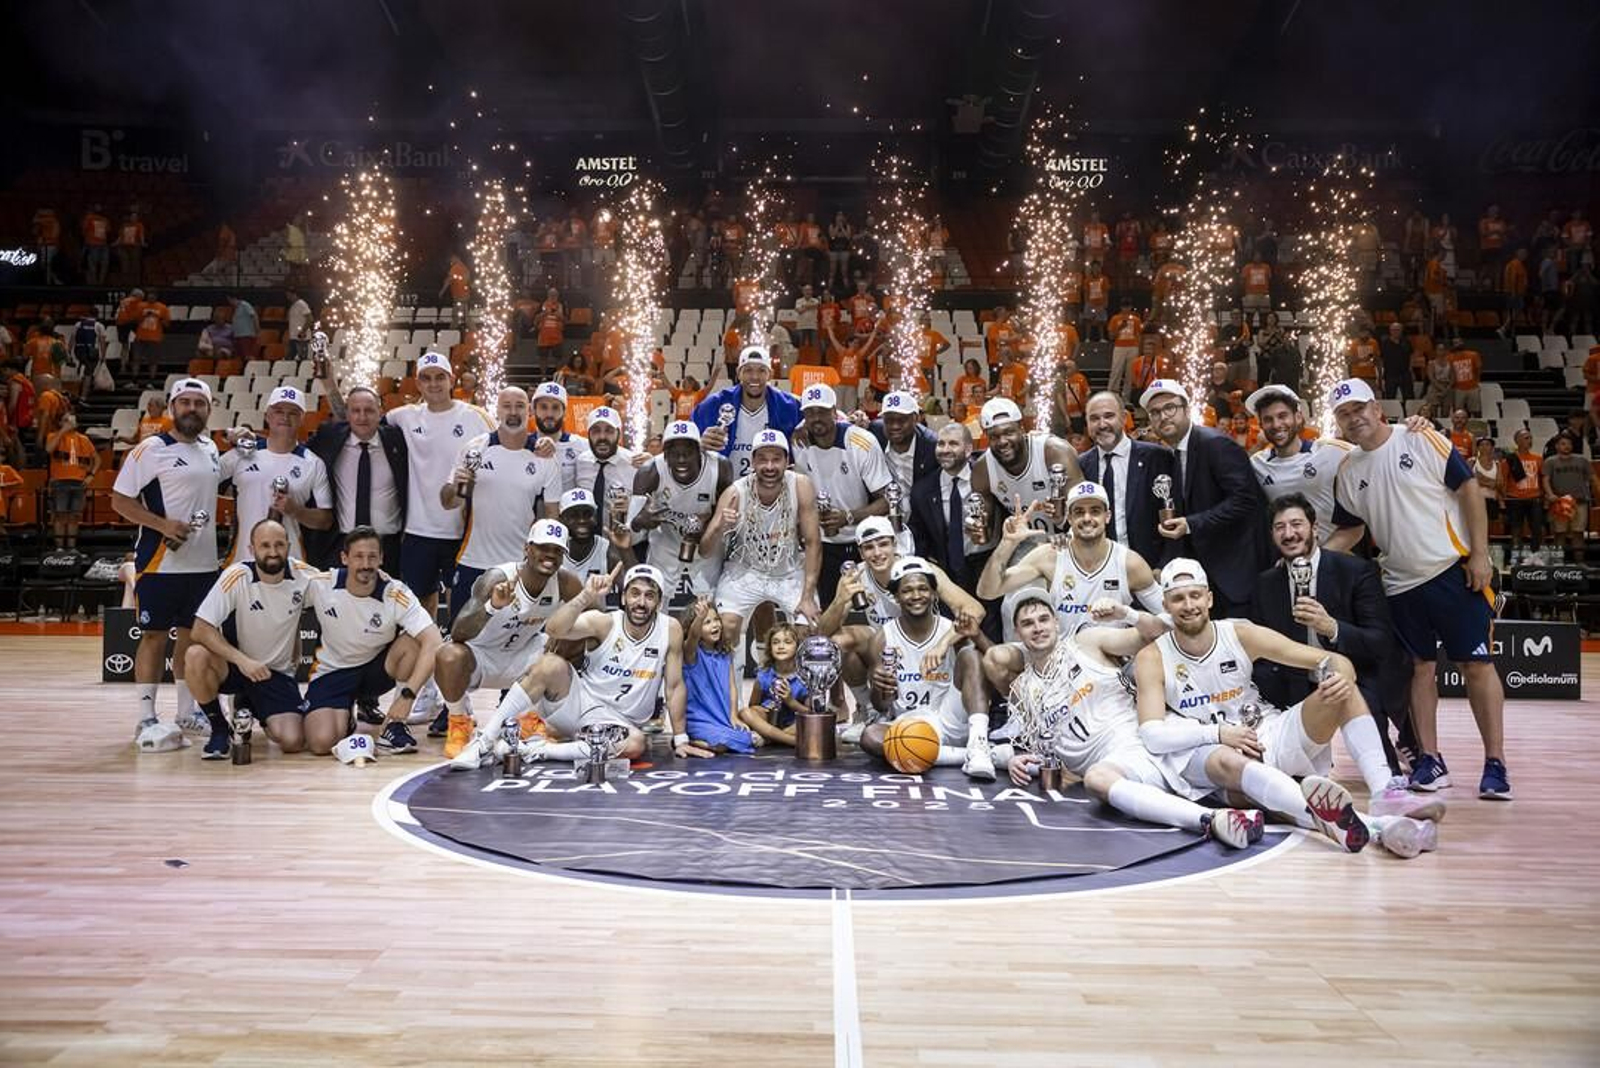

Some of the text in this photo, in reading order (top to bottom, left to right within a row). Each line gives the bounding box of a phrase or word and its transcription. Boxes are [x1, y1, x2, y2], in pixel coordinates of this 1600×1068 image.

[319, 141, 451, 167] CaixaBank
[1261, 141, 1405, 169] CaixaBank
[117, 153, 189, 173] travel
[575, 156, 637, 171] AMSTEL
[1045, 157, 1107, 172] AMSTEL
[424, 355, 438, 365] 38
[280, 389, 296, 400] 38
[546, 384, 560, 395] 38
[807, 389, 821, 401] 38
[1333, 383, 1351, 400] 38
[887, 396, 901, 407] 38
[595, 409, 610, 418] 38
[673, 424, 688, 434] 38
[762, 432, 776, 443] 38
[1078, 484, 1094, 494] 38
[571, 491, 586, 501] 38
[546, 524, 562, 538] 38
[898, 672, 950, 682] UTOHERO
[1507, 672, 1578, 687] mediolanum
[615, 684, 632, 702] 7
[905, 690, 930, 711] 24
[1069, 715, 1090, 742] 11
[349, 737, 367, 750] 38
[645, 769, 924, 783] endesa
[481, 779, 1091, 803] PLAYOFF FINAL
[822, 798, 995, 811] 2025
